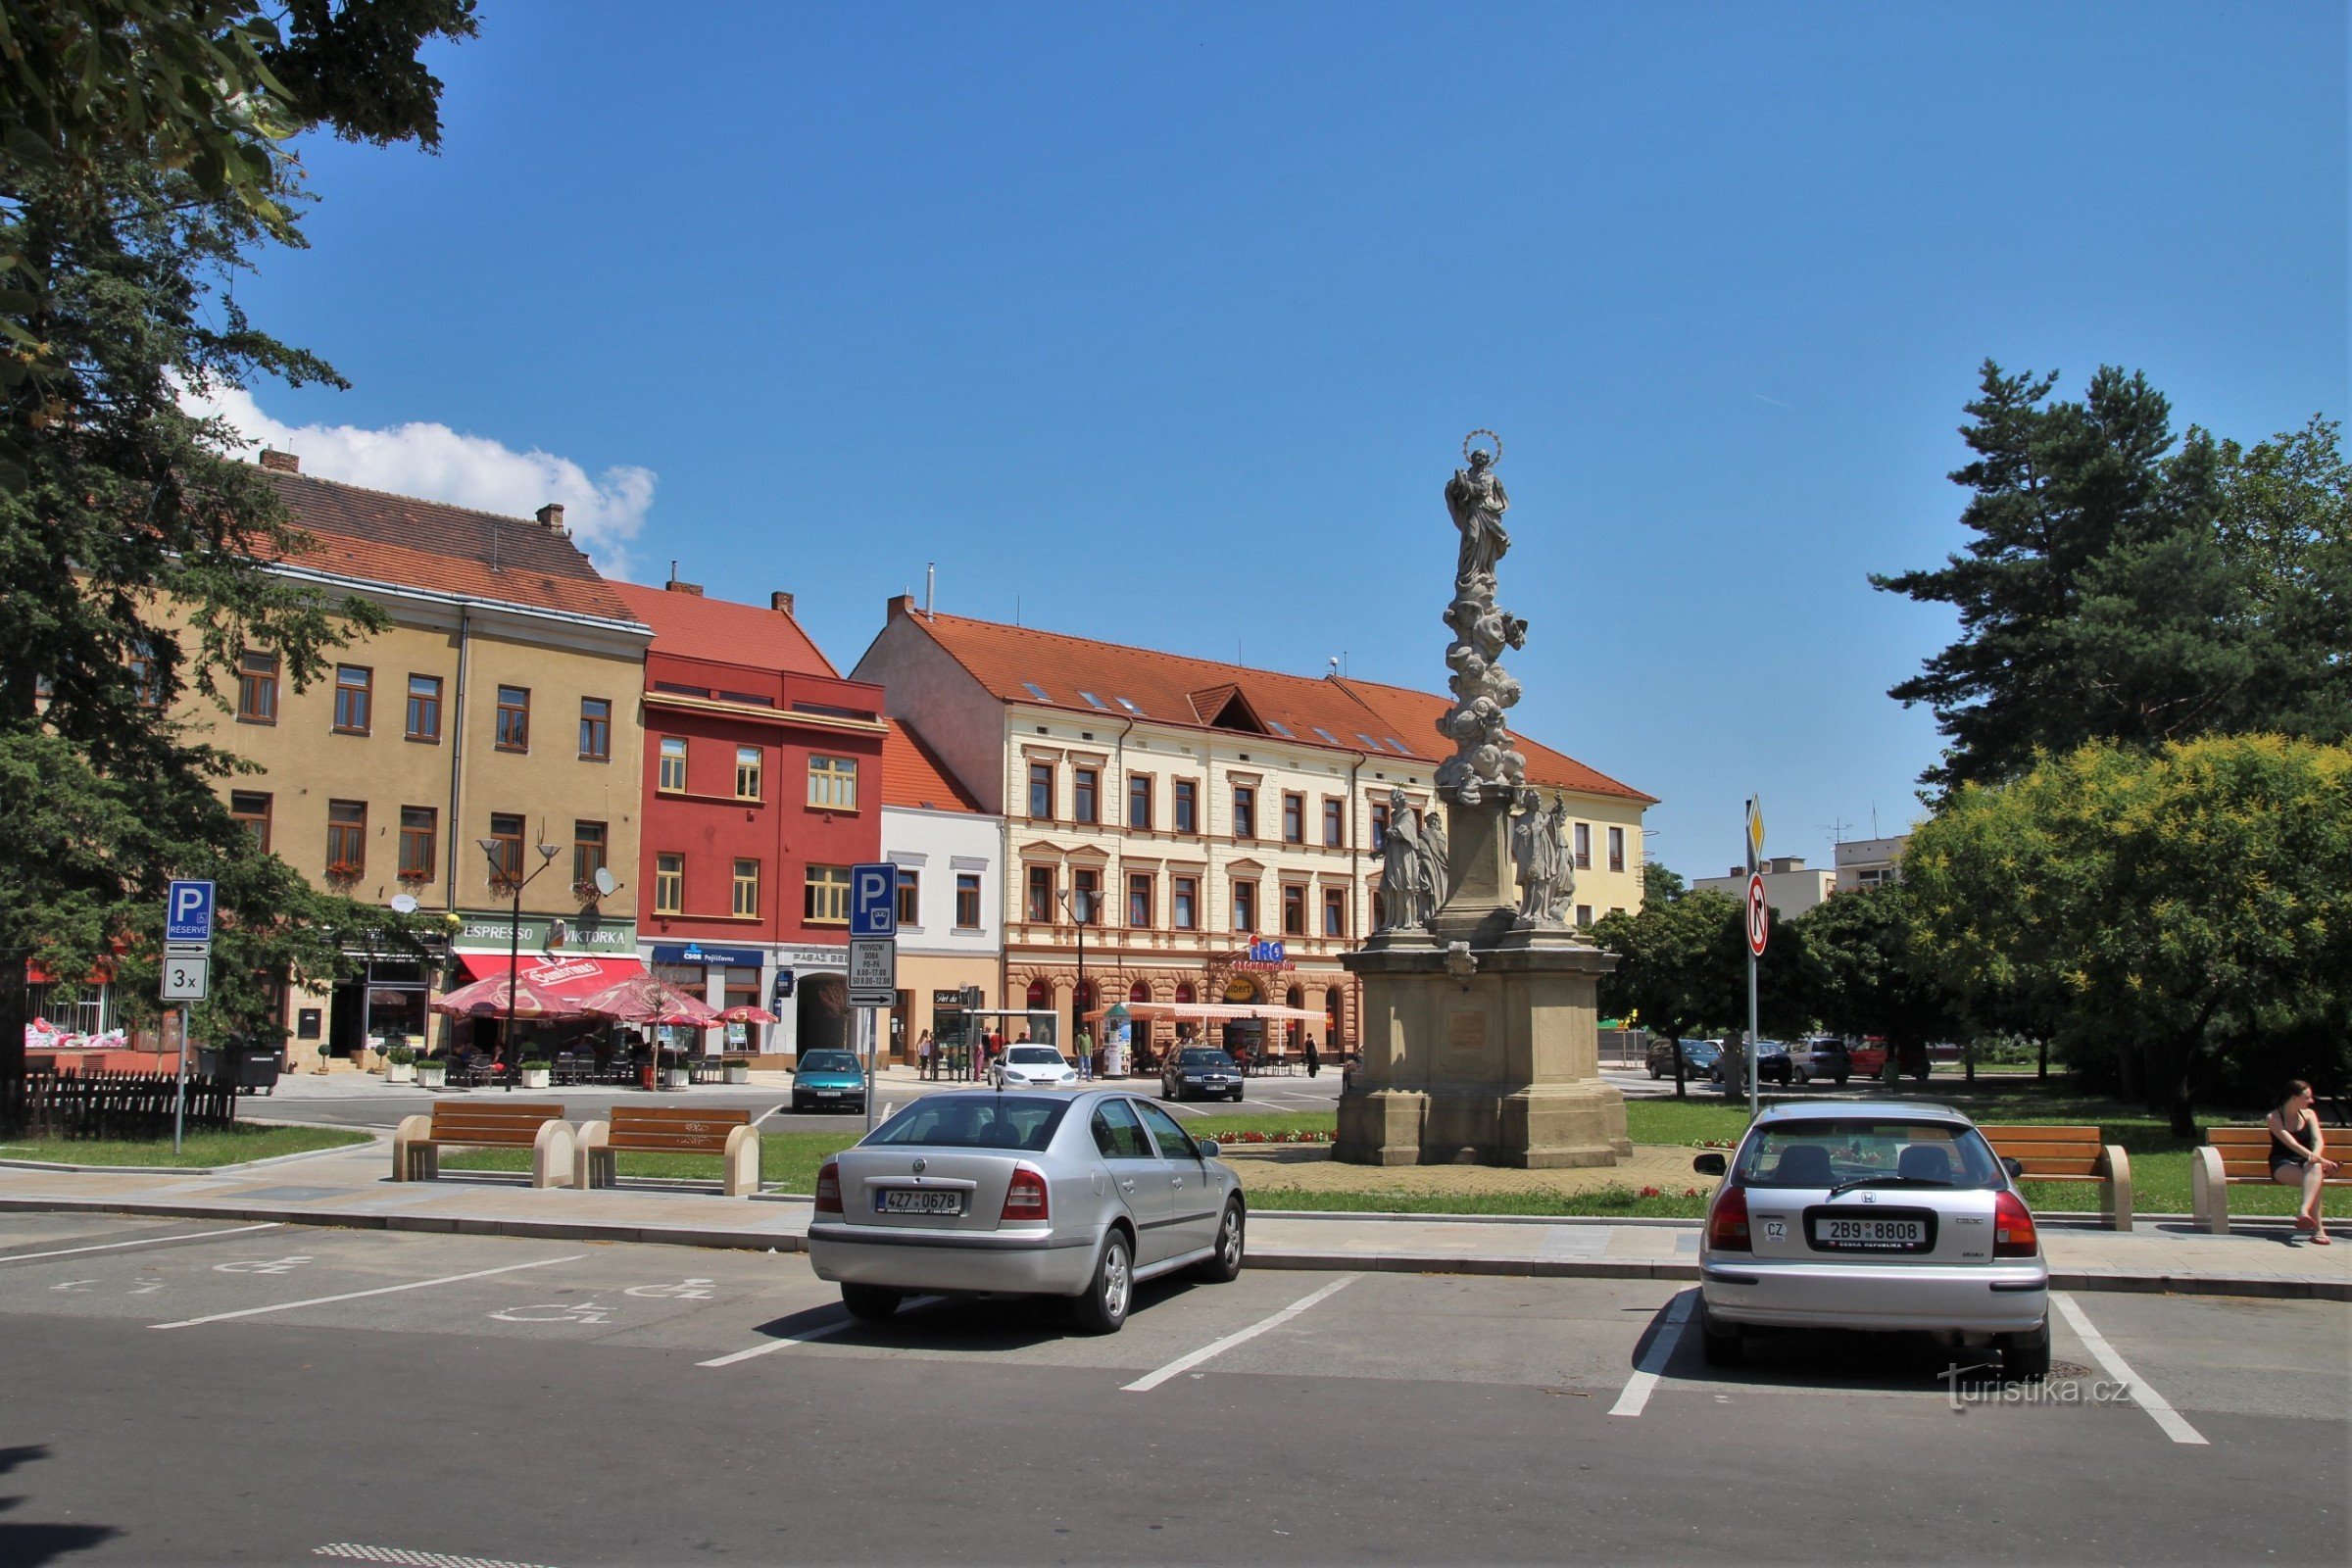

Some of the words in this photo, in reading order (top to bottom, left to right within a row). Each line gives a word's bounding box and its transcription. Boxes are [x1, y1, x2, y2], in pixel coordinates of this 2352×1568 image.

[860, 873, 887, 913] P
[177, 888, 204, 922] P
[464, 925, 533, 941] ESPRESSO
[564, 930, 625, 945] VIKTORKA
[528, 962, 597, 984] Gambrinus
[1225, 984, 1250, 994] albert
[888, 1193, 912, 1207] 4Z7
[922, 1194, 956, 1208] 0678
[1768, 1223, 1783, 1236] CZ
[1831, 1221, 1861, 1239] 2B9
[1875, 1222, 1917, 1240] 8808
